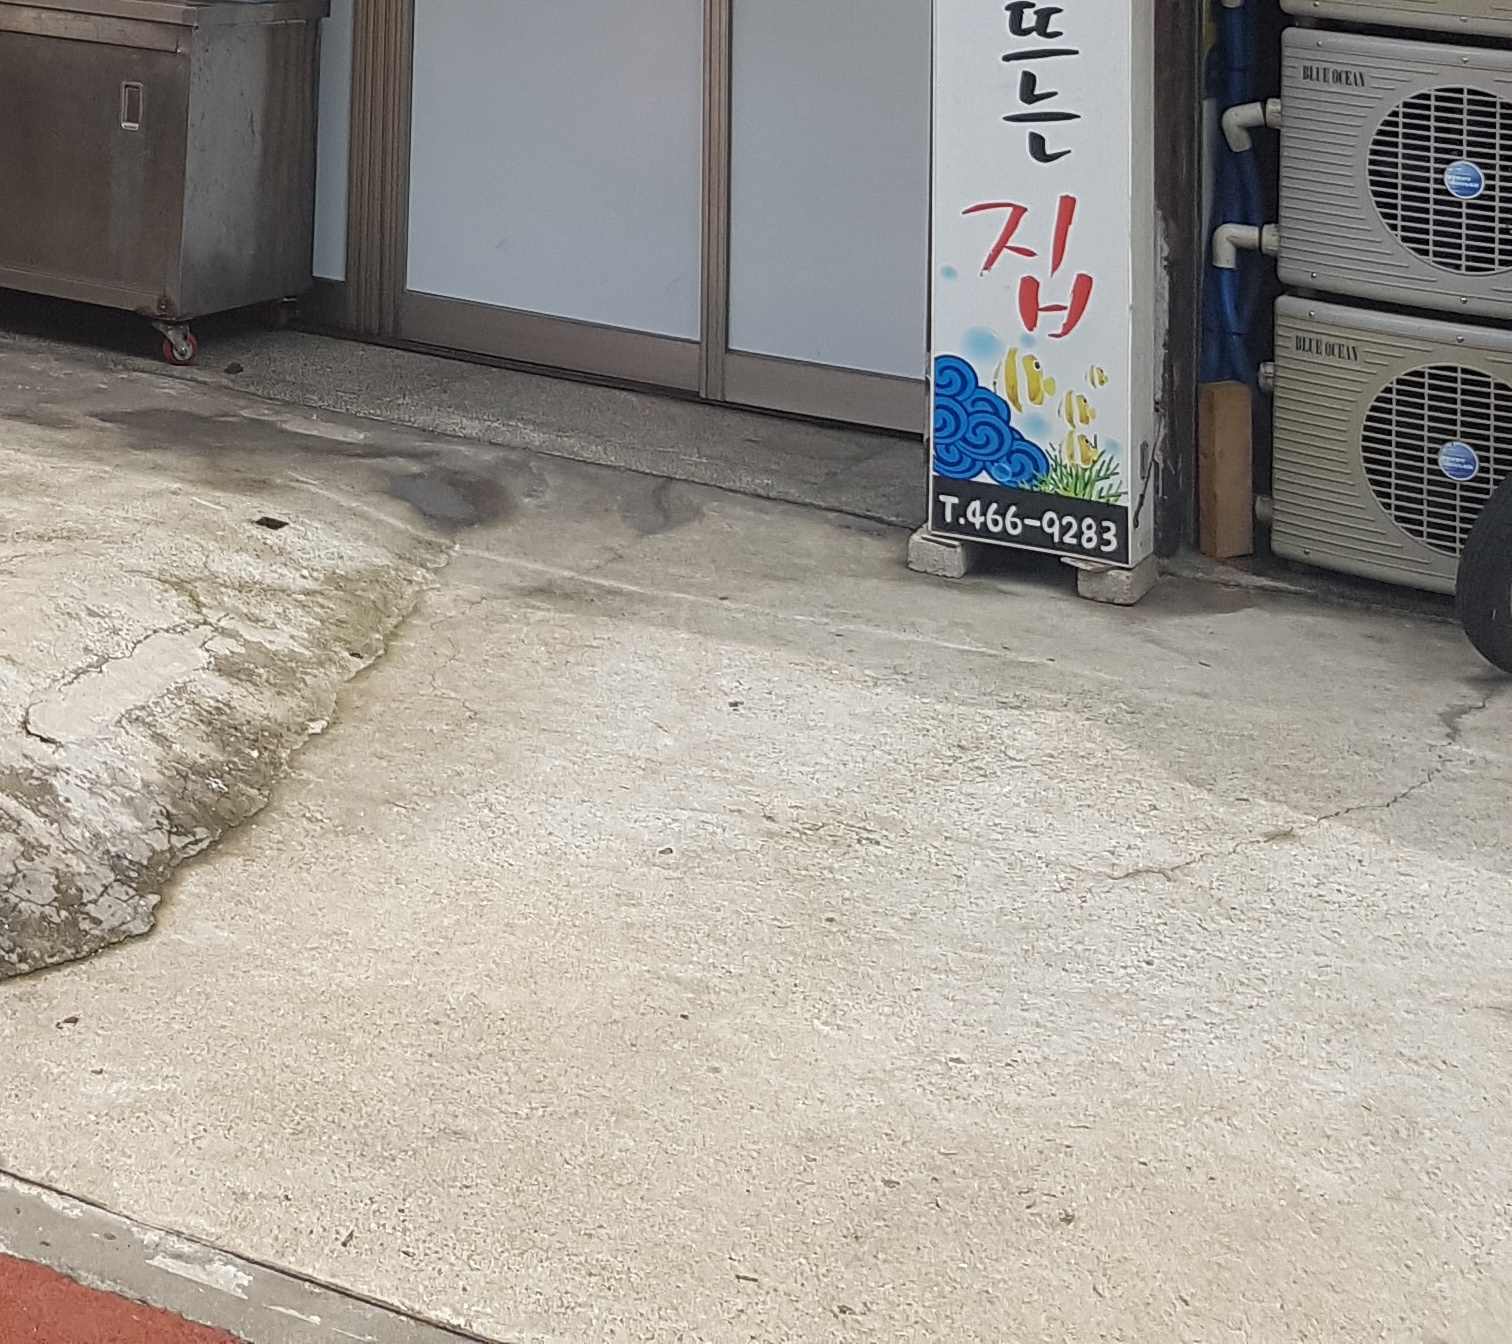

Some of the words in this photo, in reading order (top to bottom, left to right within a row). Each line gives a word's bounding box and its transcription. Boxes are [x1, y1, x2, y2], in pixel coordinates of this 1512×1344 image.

[1000, 0, 1082, 165] 뜨는
[1302, 65, 1330, 83] BLUE
[1331, 68, 1366, 88] OCEAN
[962, 194, 1094, 339] 집
[1294, 335, 1323, 355] BLUE
[1324, 340, 1358, 362] OCEAN
[939, 492, 1119, 555] T.466-9283
